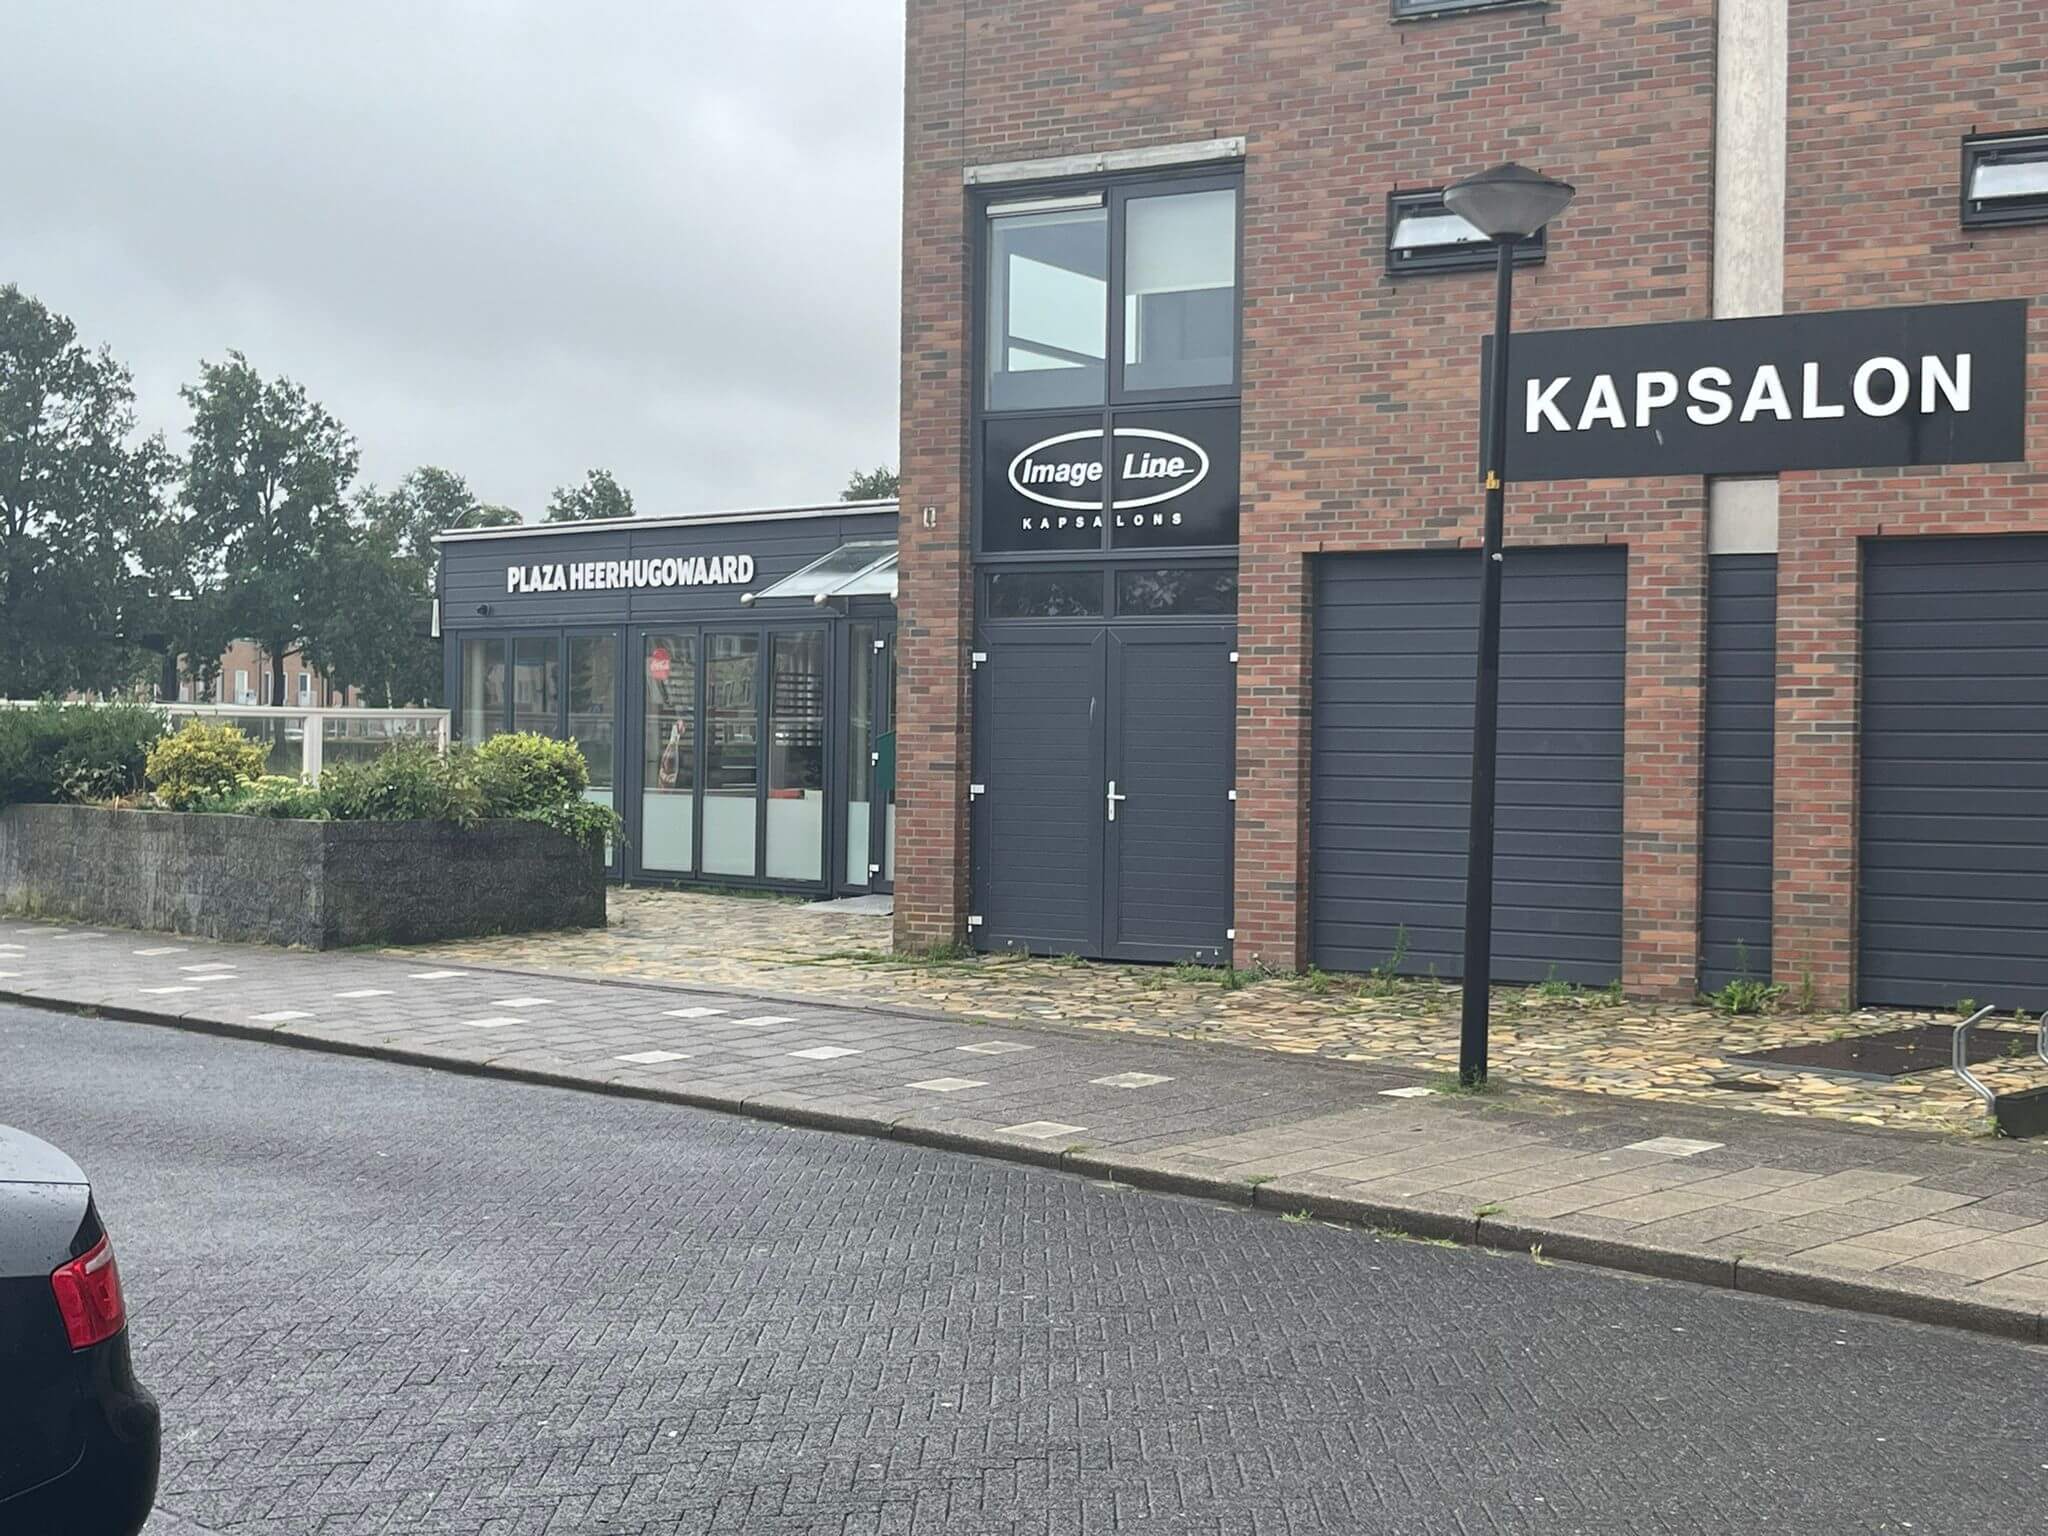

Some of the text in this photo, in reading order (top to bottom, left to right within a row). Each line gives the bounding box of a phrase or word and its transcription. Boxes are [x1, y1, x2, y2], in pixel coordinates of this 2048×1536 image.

[1525, 353, 1971, 433] KAPSALON
[1022, 453, 1195, 487] Image Line
[1022, 513, 1182, 530] KAPSALONS
[507, 555, 754, 593] PLAZA HEERHUGOWAARD
